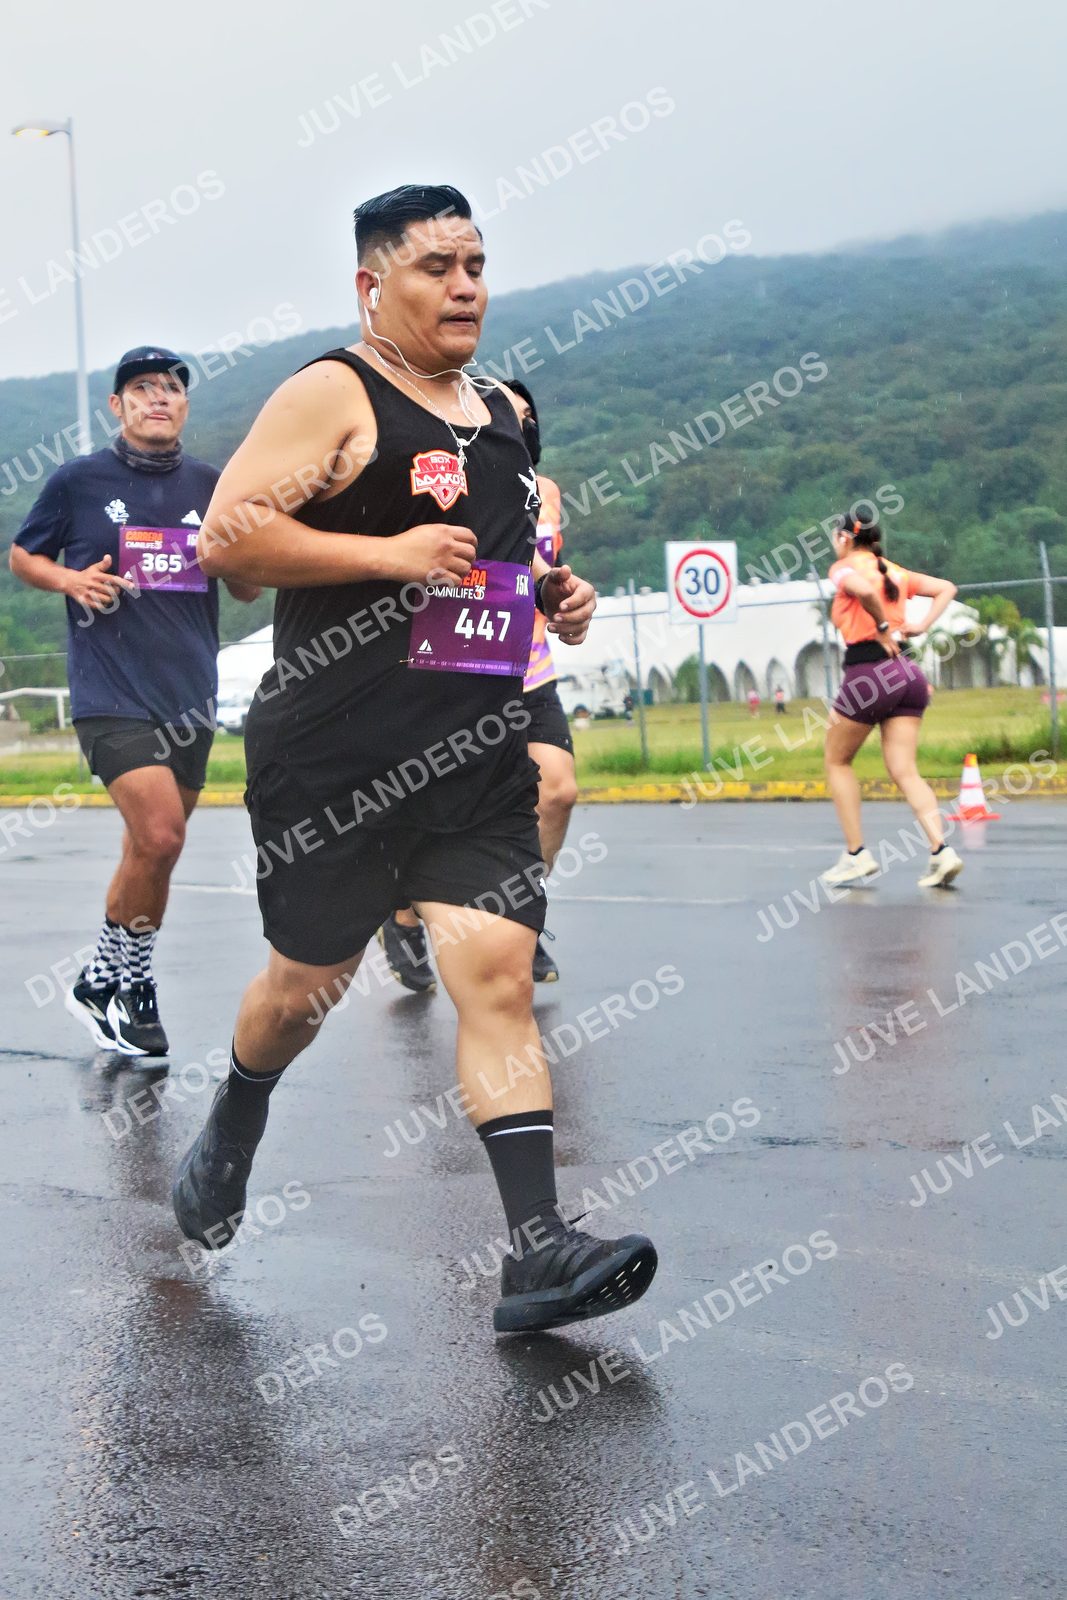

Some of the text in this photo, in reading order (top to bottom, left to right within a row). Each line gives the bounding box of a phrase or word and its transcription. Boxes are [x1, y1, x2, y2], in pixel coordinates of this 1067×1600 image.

[430, 456, 451, 464] BOX
[142, 553, 182, 573] 365
[685, 568, 720, 595] 30
[454, 608, 511, 642] 447
